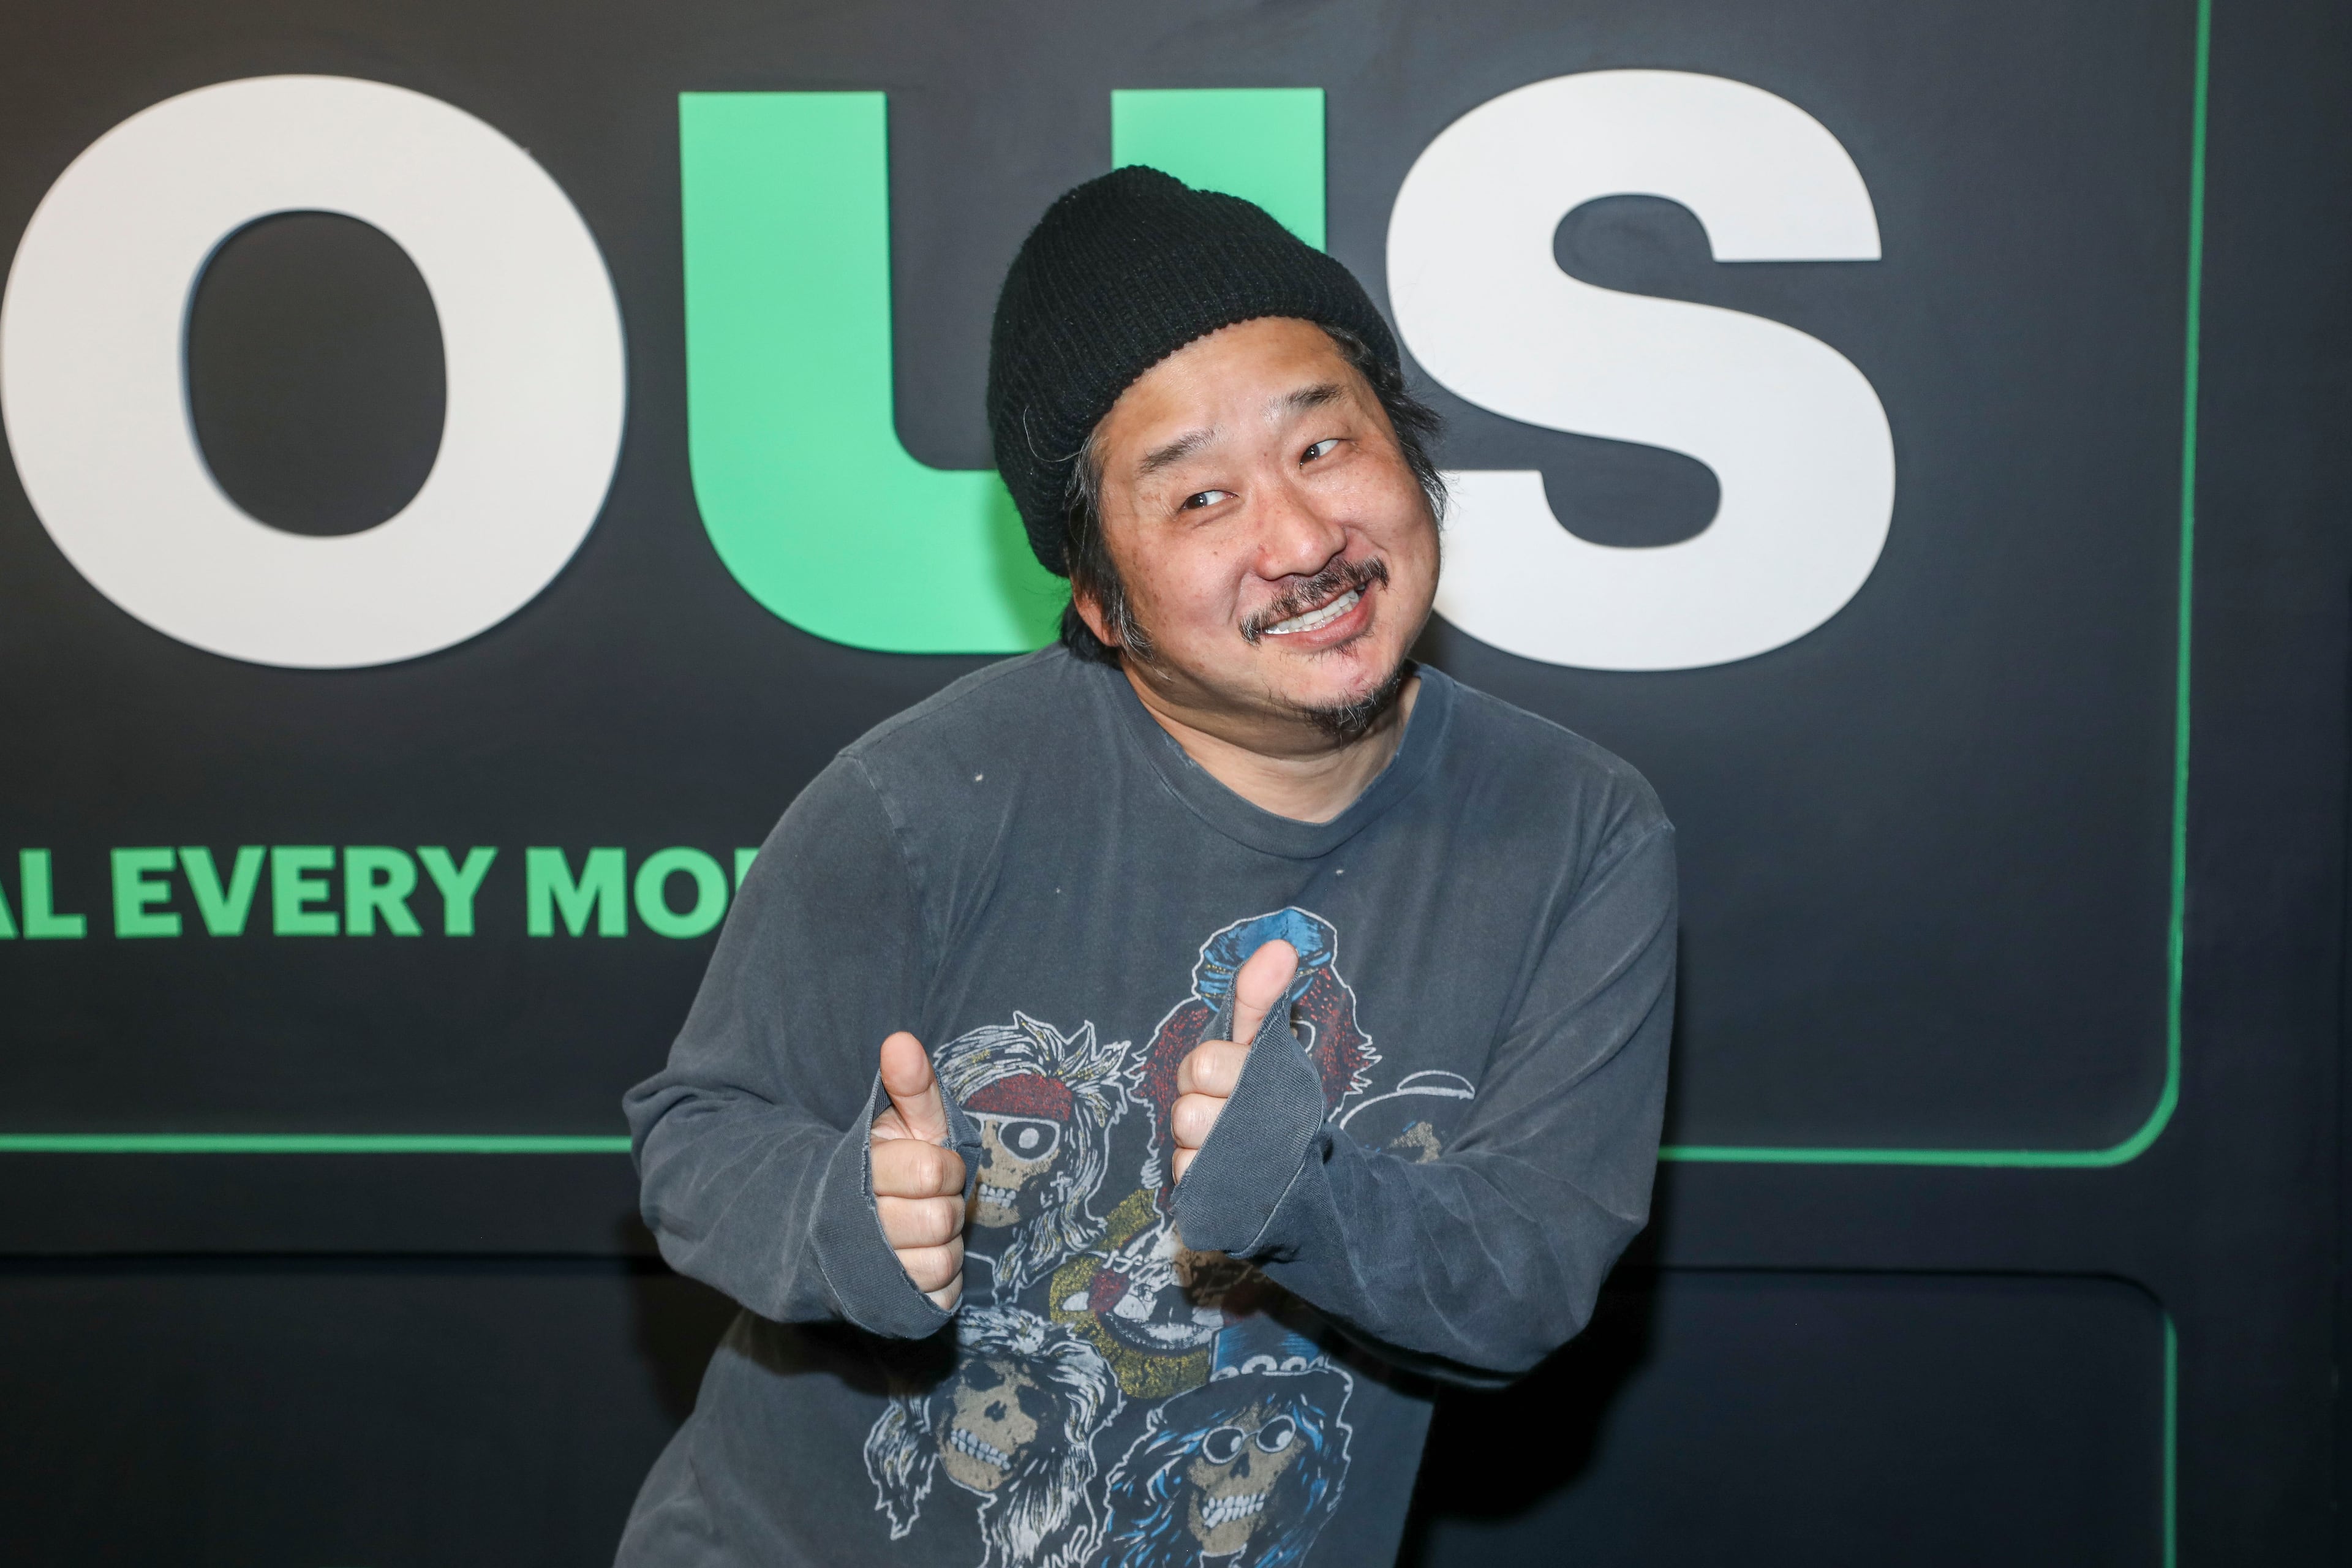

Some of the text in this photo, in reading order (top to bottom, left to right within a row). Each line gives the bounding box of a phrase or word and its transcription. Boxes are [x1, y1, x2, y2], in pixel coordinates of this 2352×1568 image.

[0, 845, 760, 940] L EVERY MO
